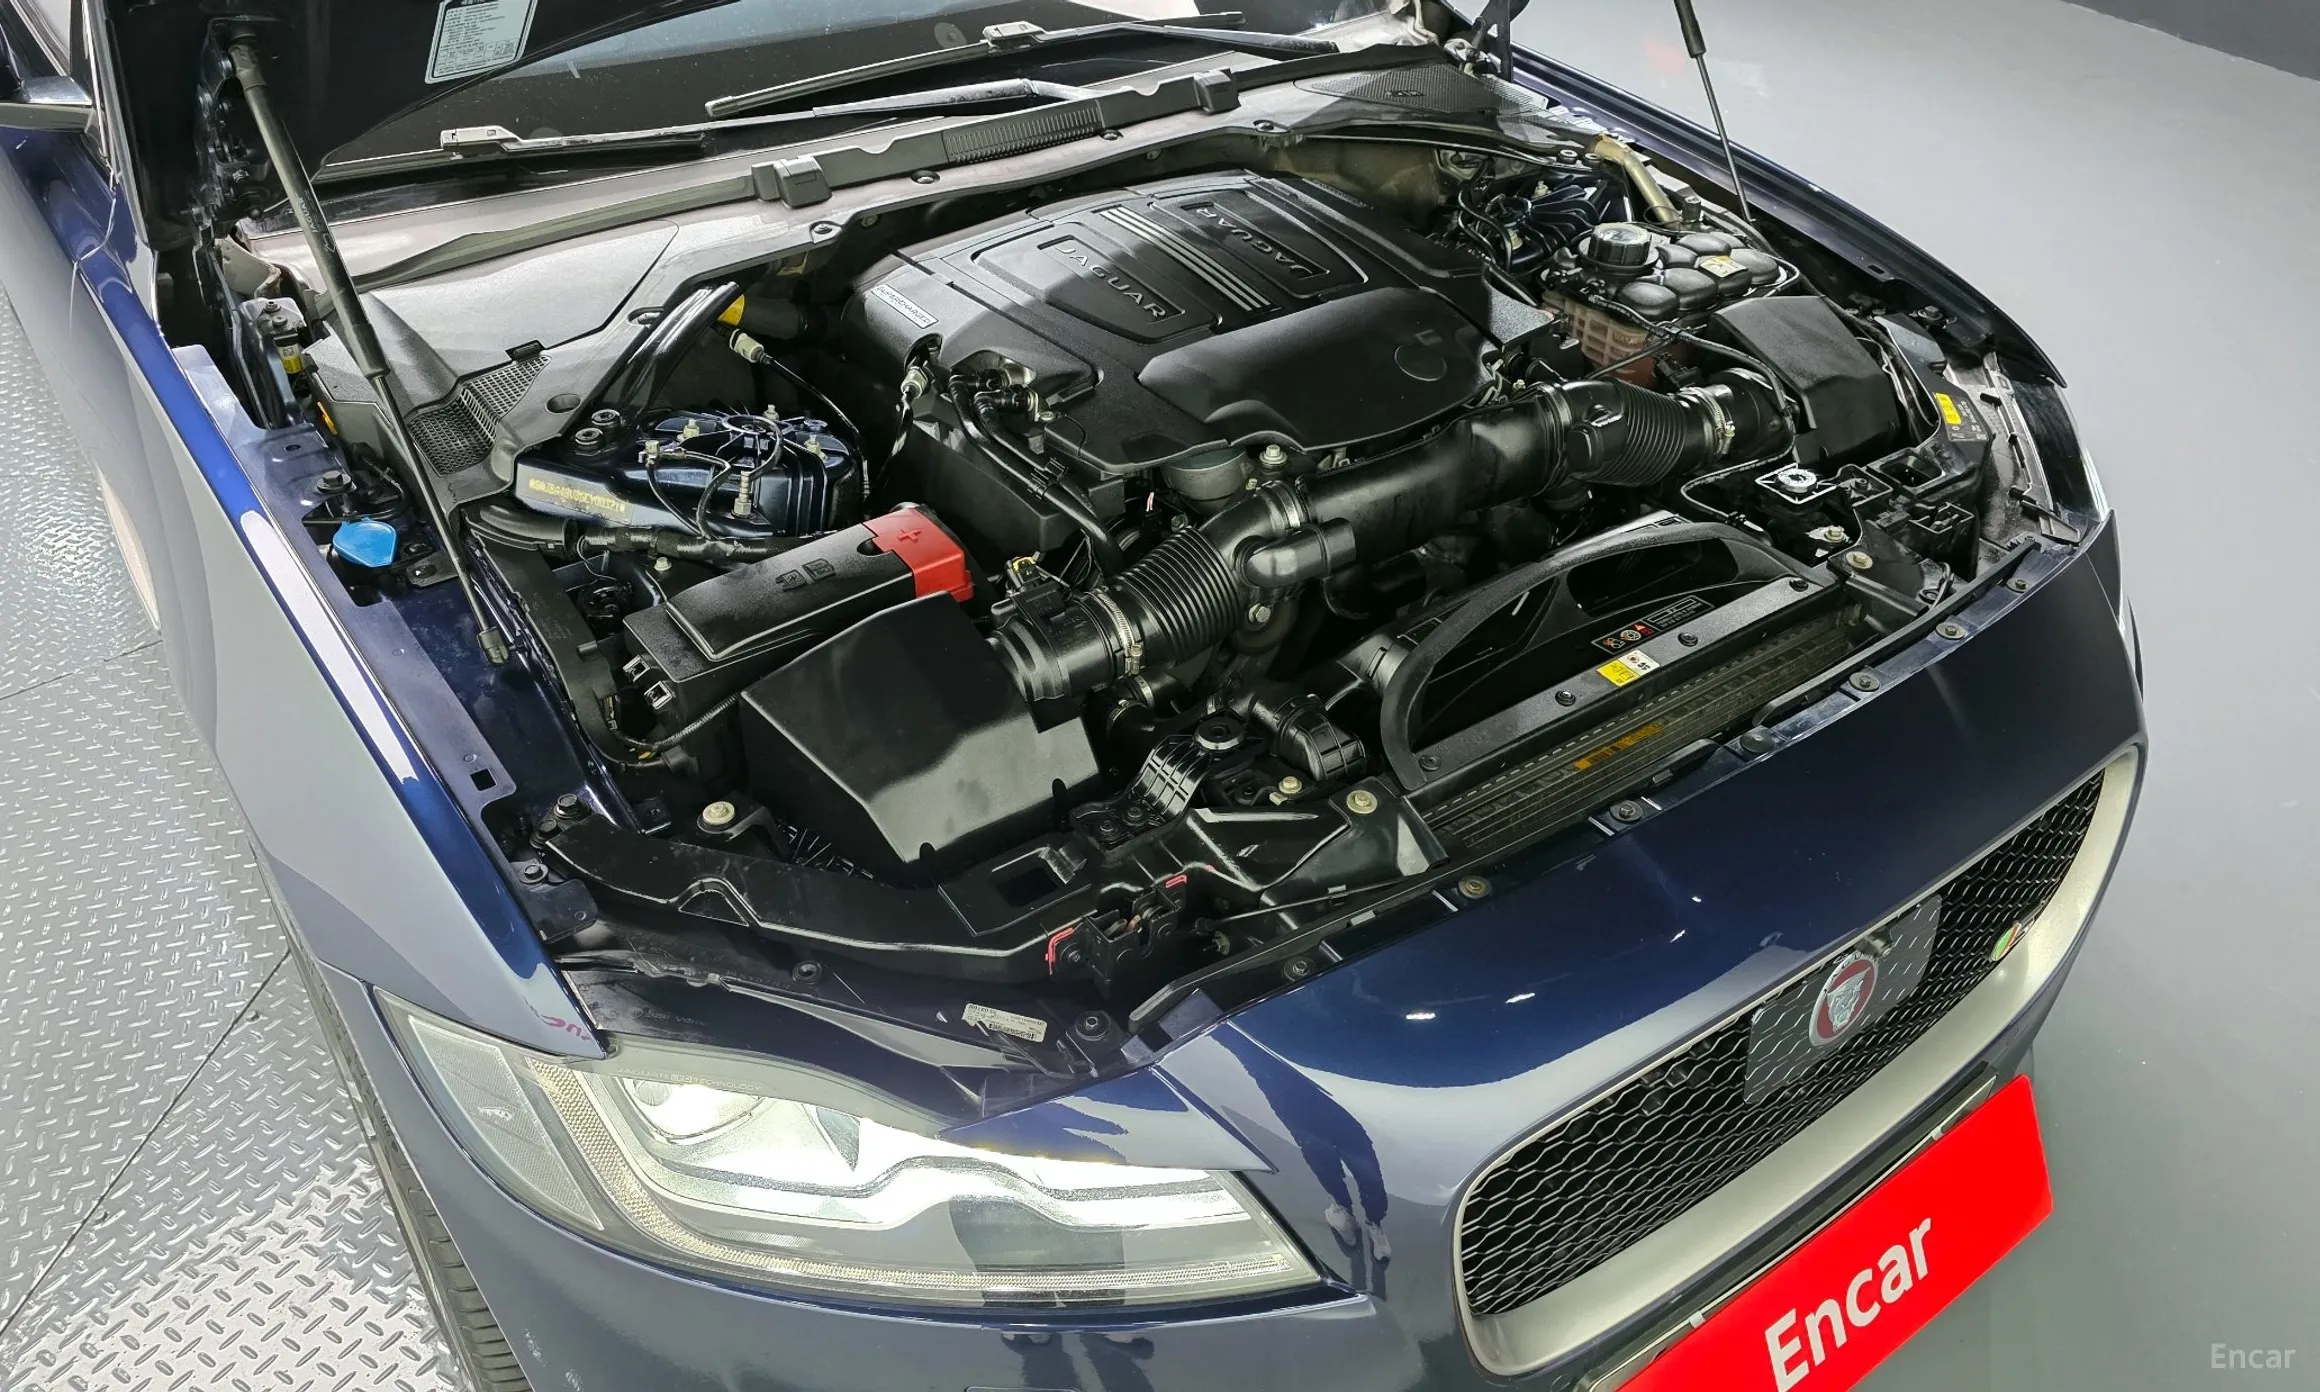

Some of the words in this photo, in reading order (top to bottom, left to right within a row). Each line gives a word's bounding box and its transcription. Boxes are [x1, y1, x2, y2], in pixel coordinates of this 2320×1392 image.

[1196, 208, 1313, 274] JAGUAR
[1054, 246, 1167, 318] JAGUAR
[1764, 1217, 1932, 1392] Encar
